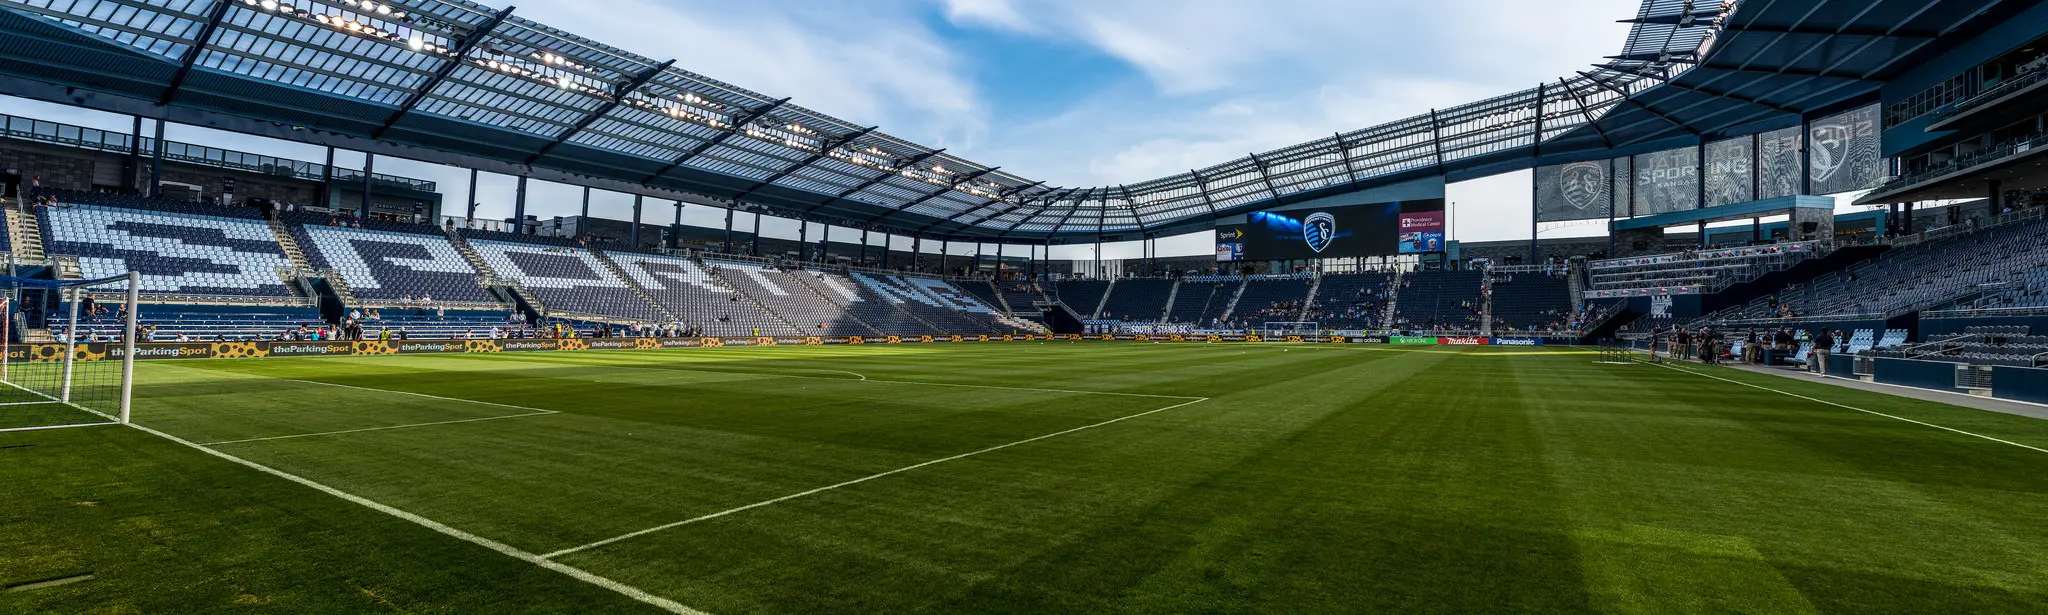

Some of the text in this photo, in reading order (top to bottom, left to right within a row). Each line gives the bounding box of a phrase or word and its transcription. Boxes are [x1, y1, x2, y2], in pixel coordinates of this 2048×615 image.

[1131, 324, 1152, 334] SOUTH
[1157, 324, 1177, 334] STAND
[111, 346, 207, 357] thParkingSpot
[273, 345, 349, 354] theParkingSpot
[402, 343, 463, 351] theParkingSpot
